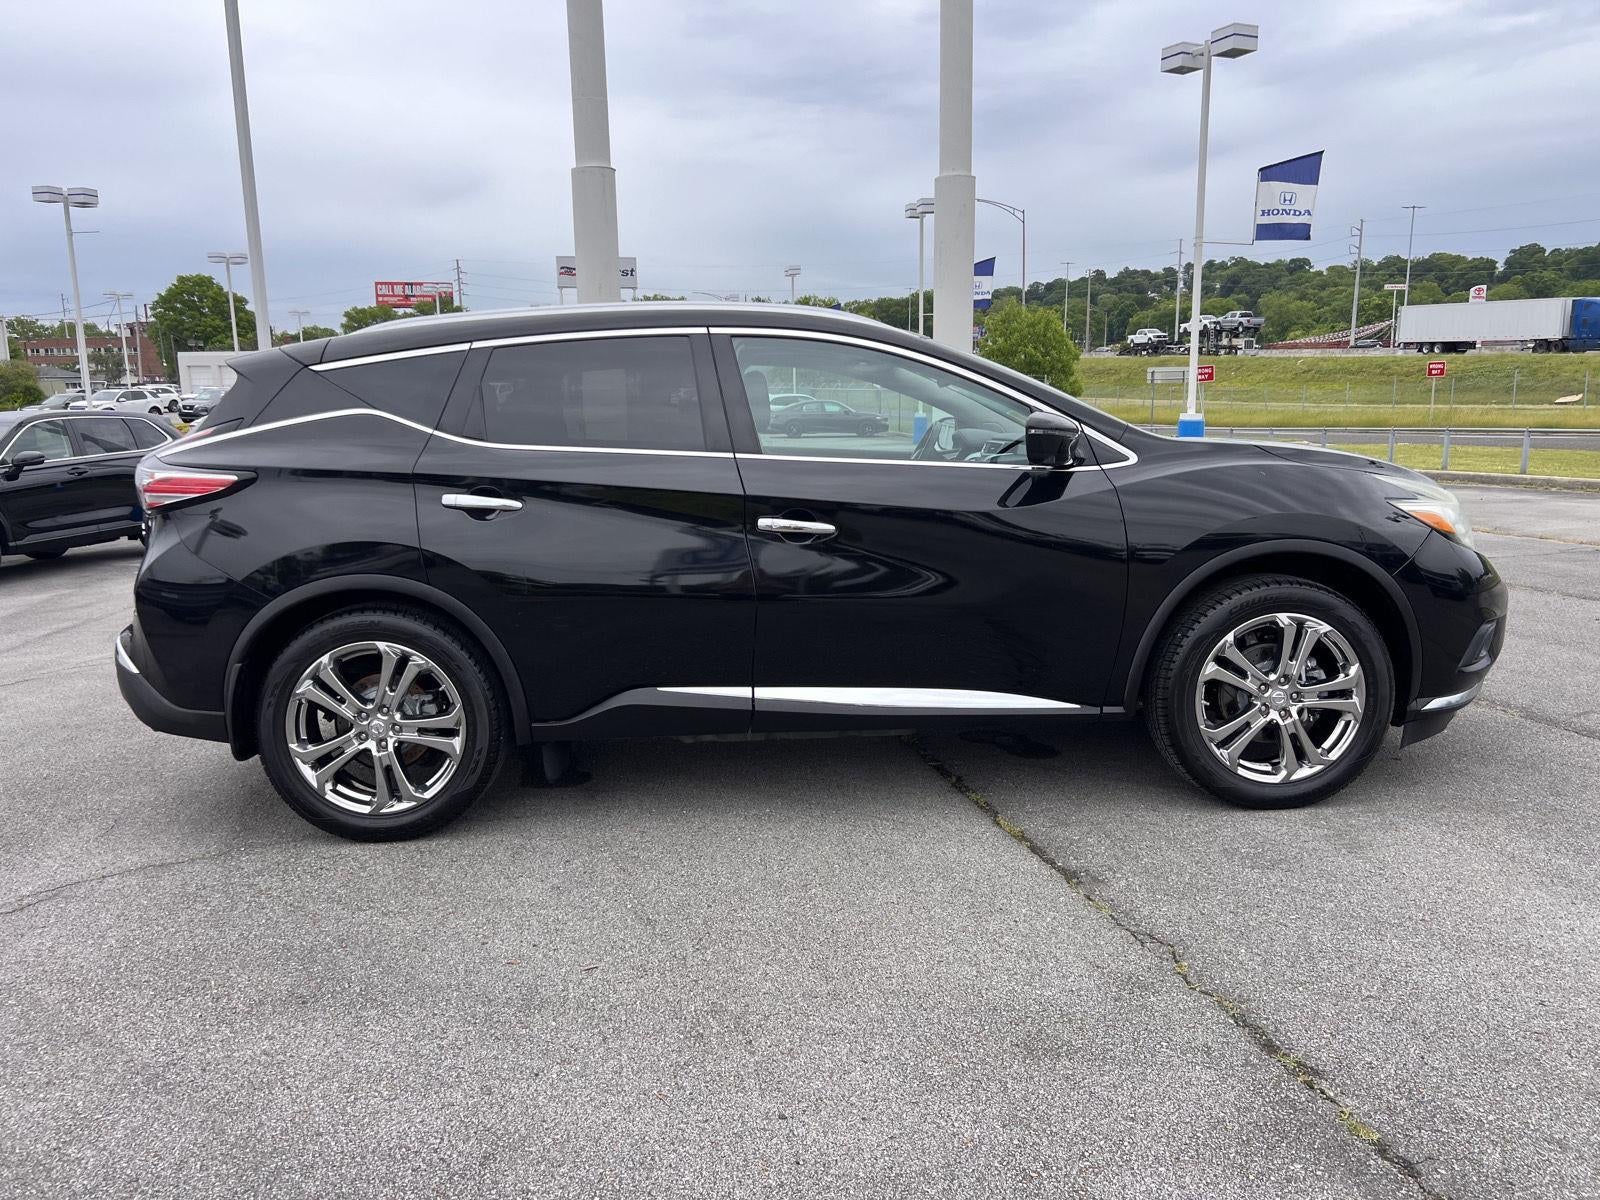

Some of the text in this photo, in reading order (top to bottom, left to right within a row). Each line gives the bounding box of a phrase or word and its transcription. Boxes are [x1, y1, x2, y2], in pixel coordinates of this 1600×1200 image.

[1260, 208, 1312, 217] HONDA
[377, 284, 393, 295] CALL
[394, 284, 404, 295] ME
